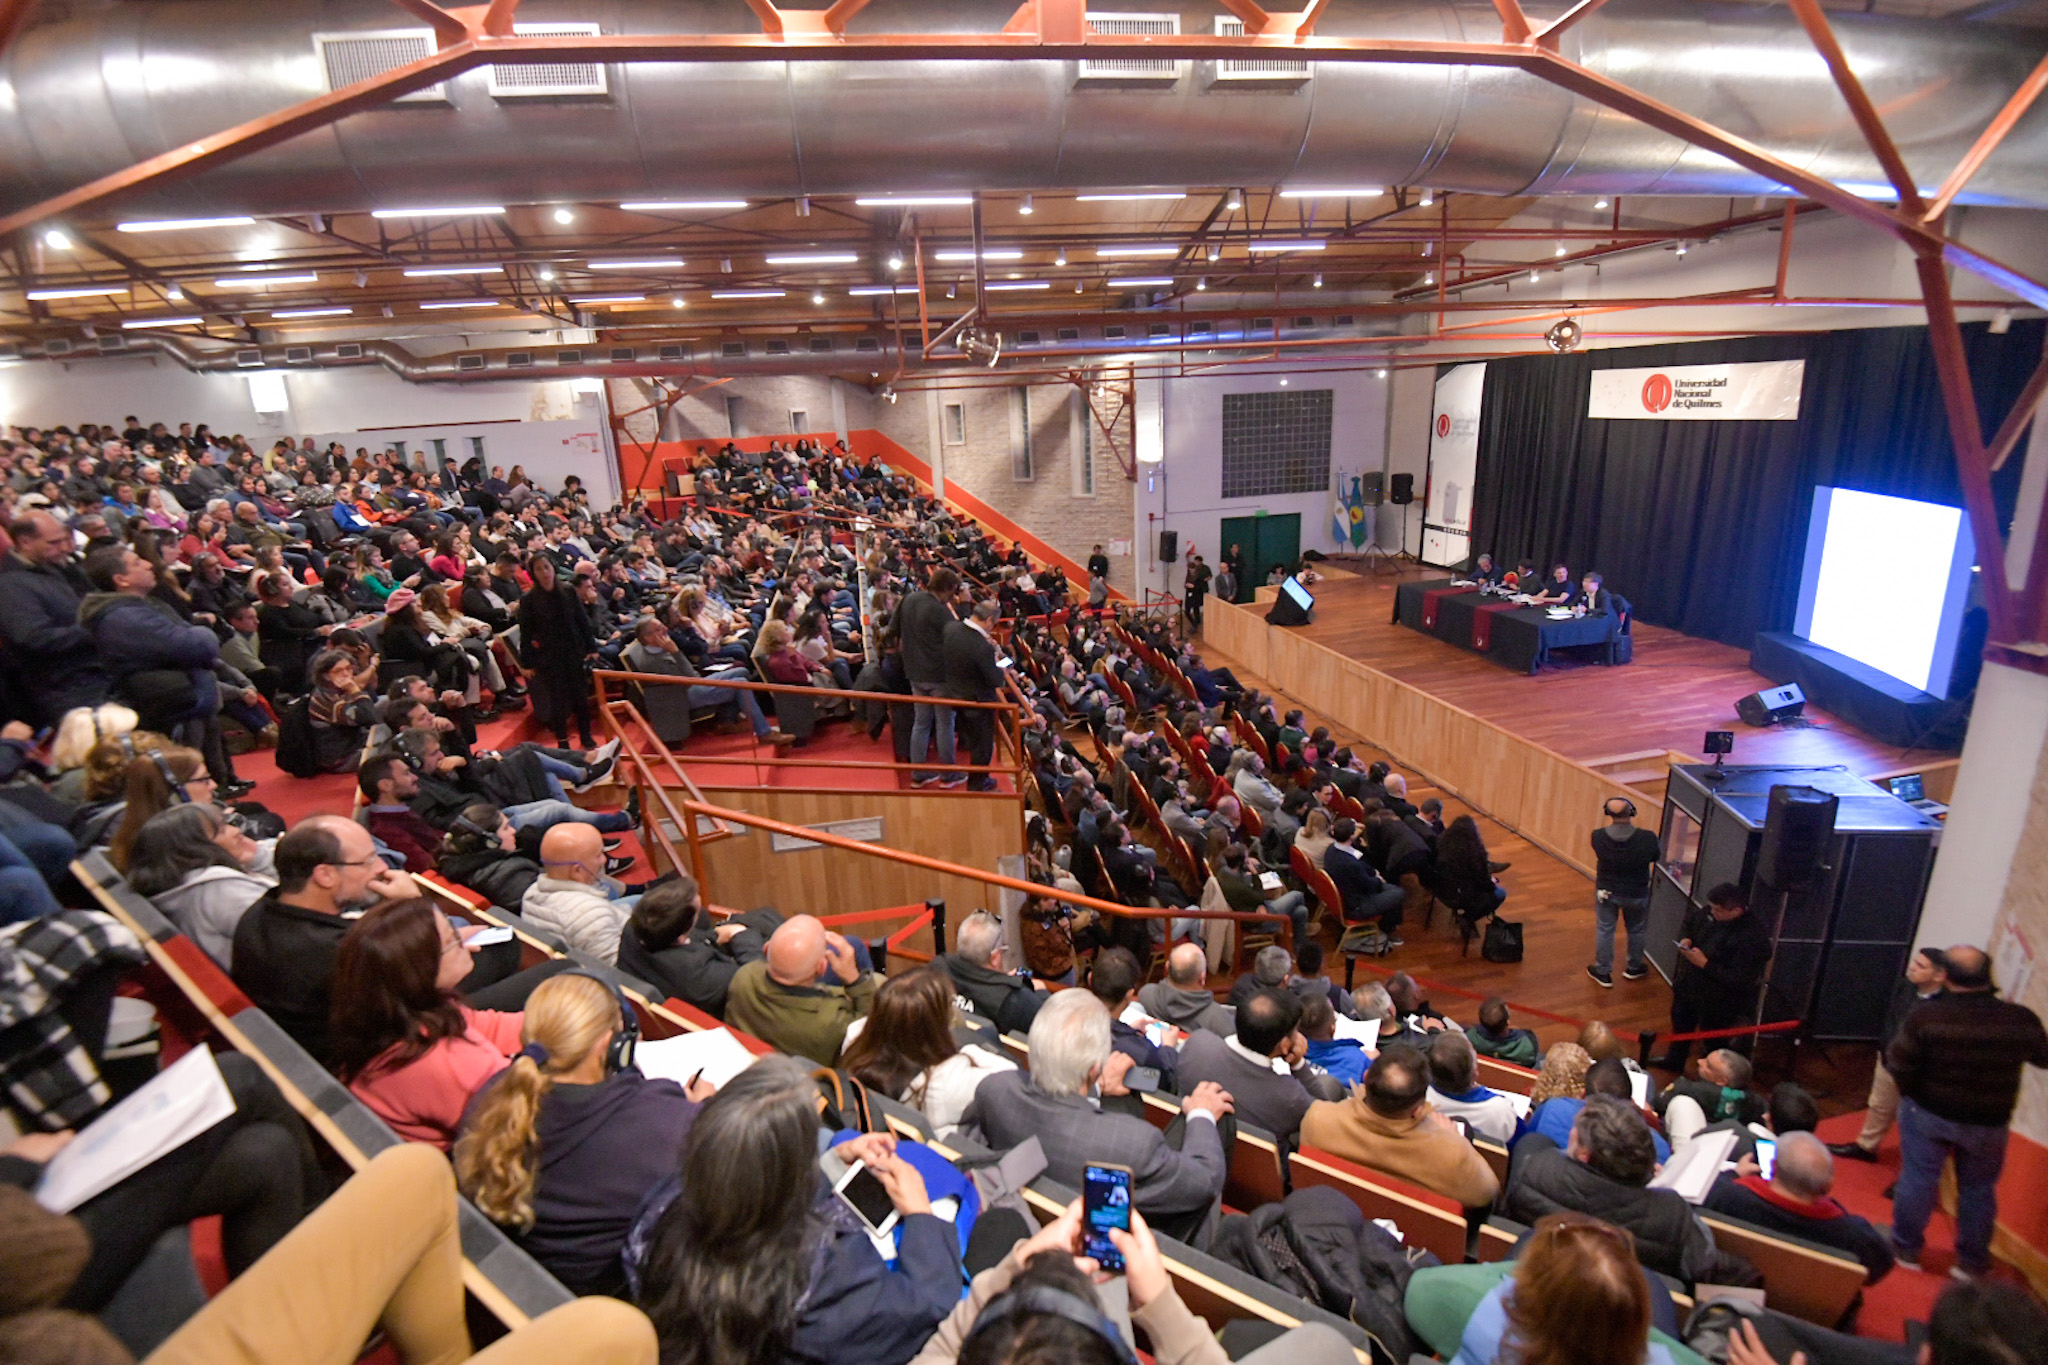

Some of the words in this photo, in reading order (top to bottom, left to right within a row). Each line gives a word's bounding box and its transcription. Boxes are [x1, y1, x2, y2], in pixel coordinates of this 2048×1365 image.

[1675, 378, 1727, 387] Universidad
[1674, 389, 1711, 397] Nacional
[1672, 399, 1683, 407] de
[1684, 399, 1722, 409] Quilmes
